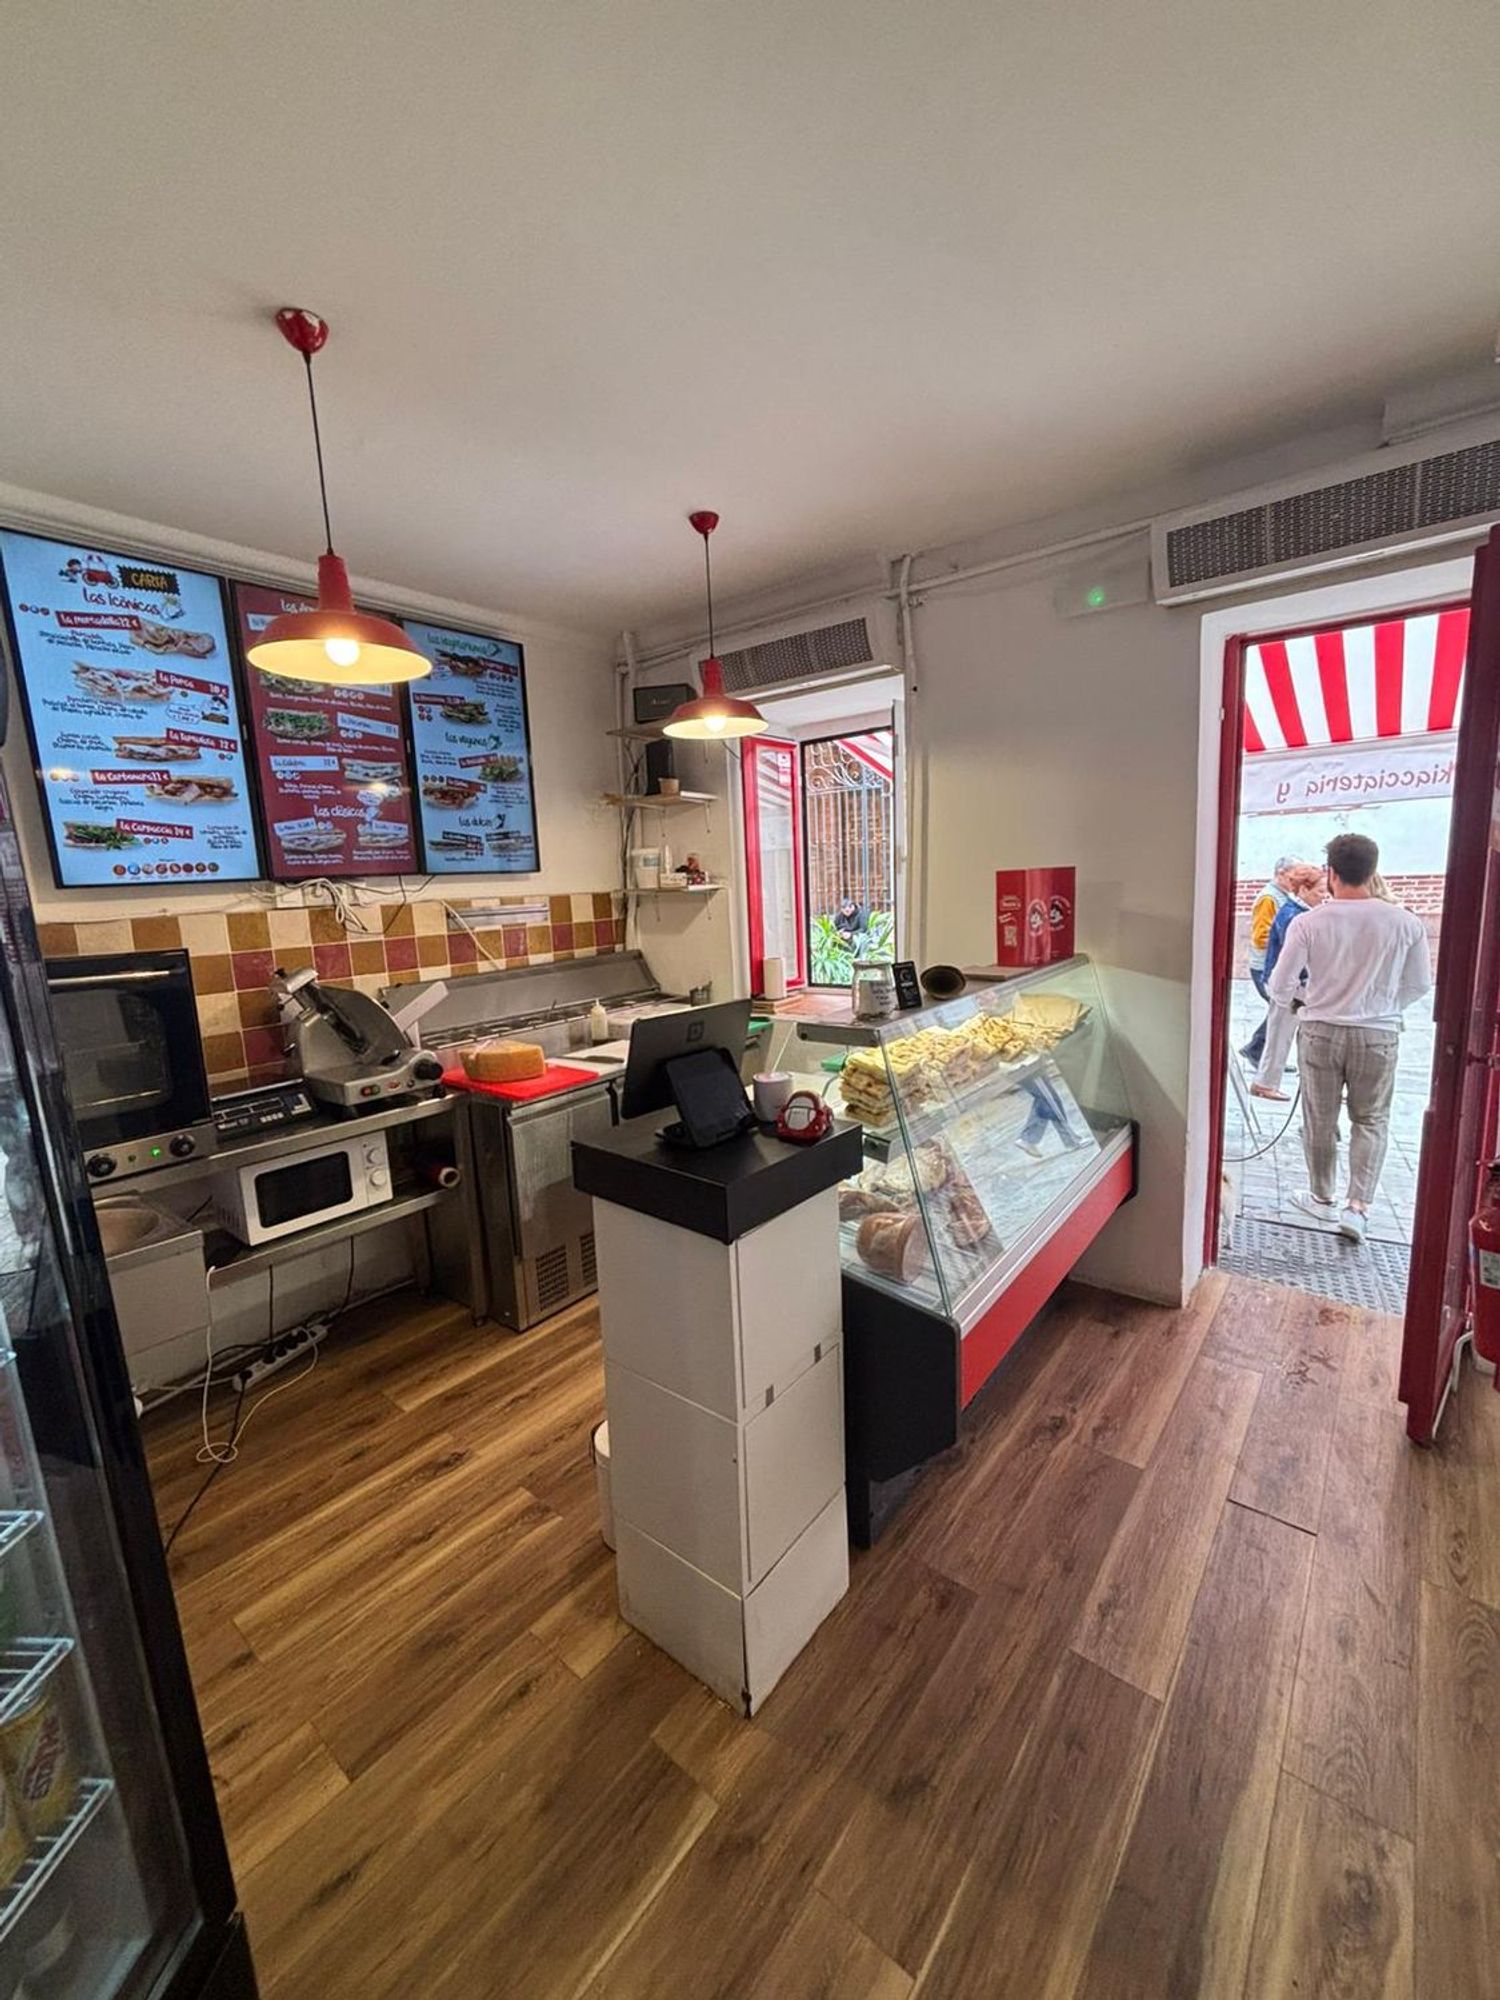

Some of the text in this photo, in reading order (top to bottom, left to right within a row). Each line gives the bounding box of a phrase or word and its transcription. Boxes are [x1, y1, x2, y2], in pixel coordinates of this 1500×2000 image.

[131, 572, 168, 589] CARTA
[83, 587, 106, 605] Las
[95, 771, 106, 781] La
[120, 821, 131, 831] La
